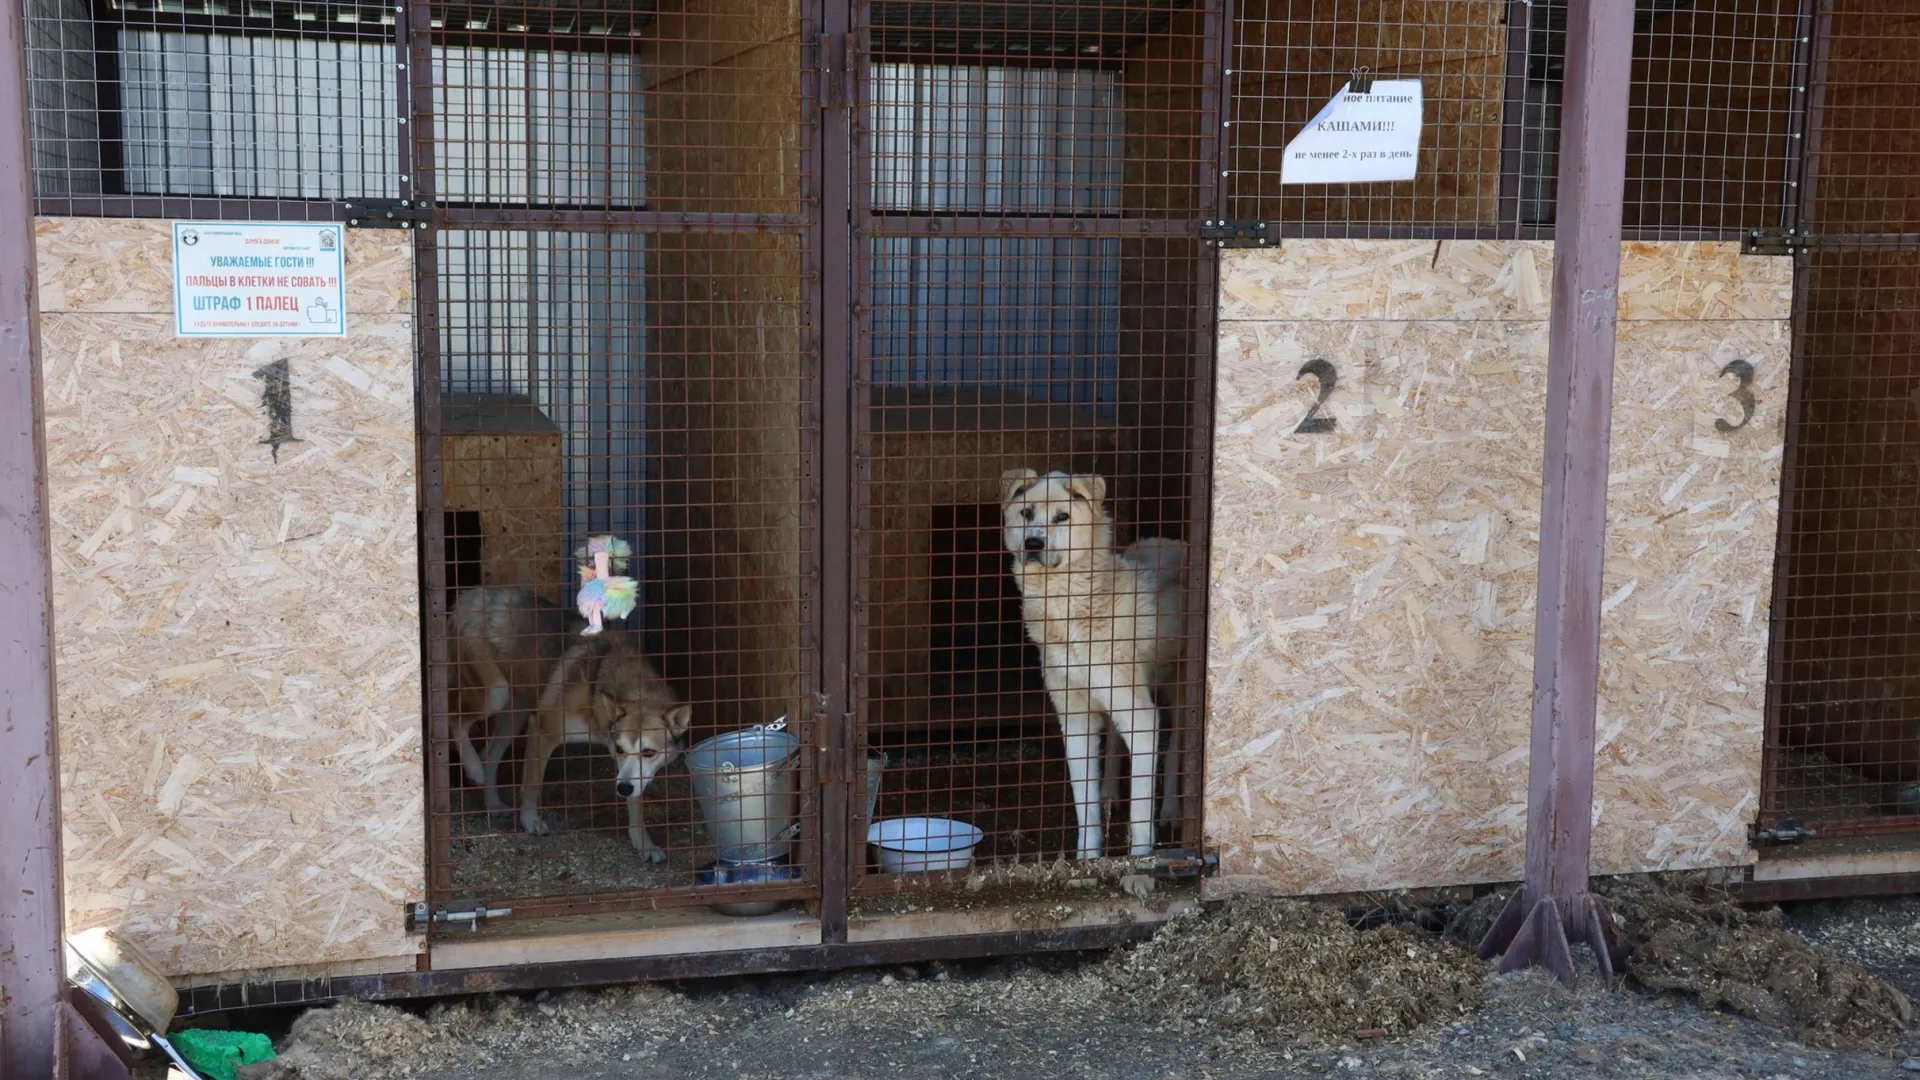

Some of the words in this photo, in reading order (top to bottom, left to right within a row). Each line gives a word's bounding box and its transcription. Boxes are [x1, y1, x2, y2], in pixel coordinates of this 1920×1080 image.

[1317, 121, 1395, 132] КАШАМИ!!!
[1295, 151, 1306, 159] не
[1309, 151, 1340, 159] менее
[1342, 149, 1357, 159] 2-х
[1360, 151, 1377, 161] раз
[1379, 151, 1386, 159] в
[1388, 150, 1412, 160] день
[210, 256, 272, 267] УВАЖАЕМЫЕ
[275, 257, 304, 268] ГОСТИ
[186, 276, 227, 288] ПАЛЬЦЫ
[230, 276, 236, 287] В
[238, 276, 276, 287] КЛЕТКИ
[277, 276, 289, 287] НЕ
[291, 276, 326, 288] СОВАТЬ
[193, 295, 241, 310] ШТРАФ
[246, 297, 252, 310] 1
[256, 296, 299, 312] ПАЛЕЦ
[1293, 358, 1337, 434] 2
[1715, 359, 1756, 432] 3
[252, 358, 305, 462] 1
